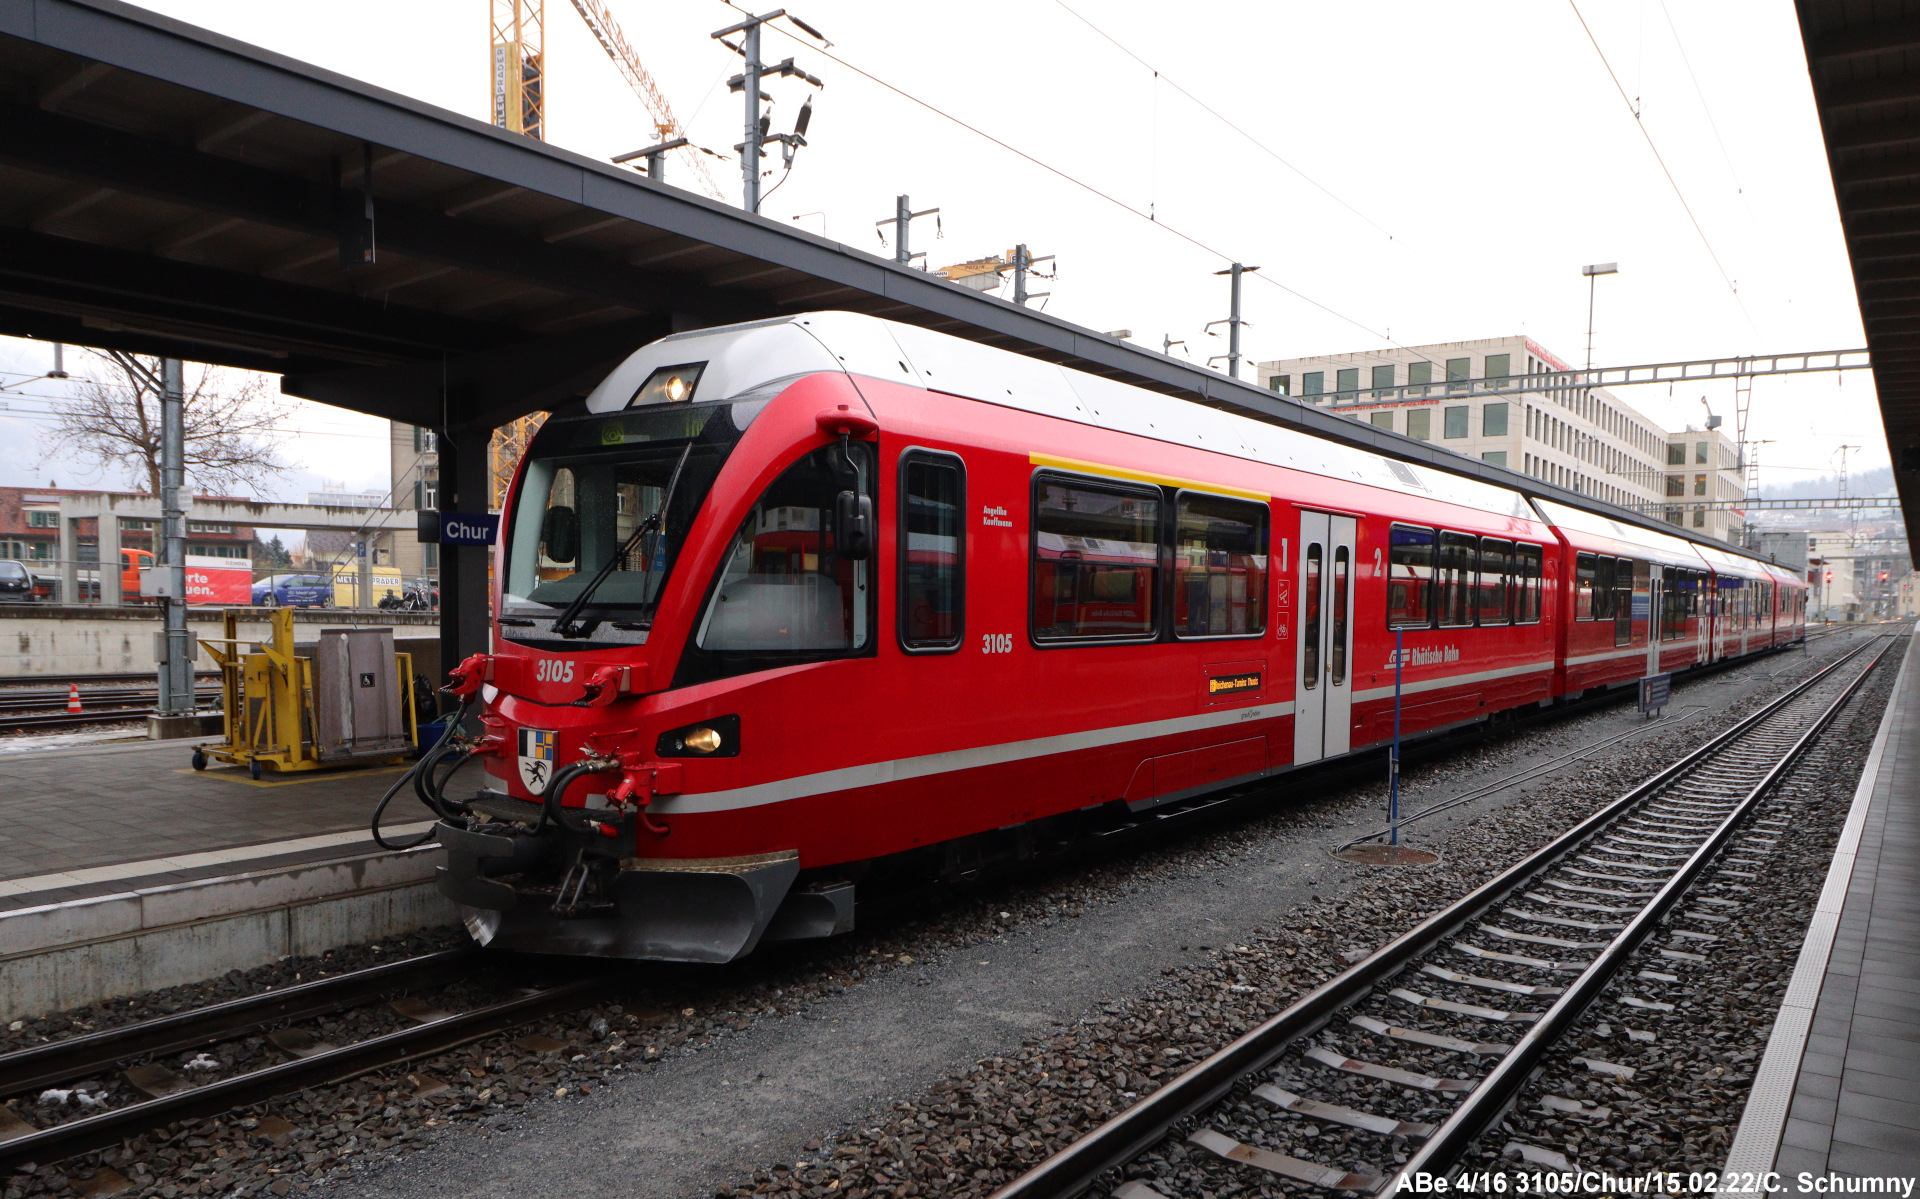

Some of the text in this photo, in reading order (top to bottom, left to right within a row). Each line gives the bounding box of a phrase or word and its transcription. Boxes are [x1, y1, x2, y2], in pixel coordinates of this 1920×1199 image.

[983, 505, 1007, 517] Angelika
[983, 516, 1013, 528] Kauffmann
[446, 521, 490, 540] Chur
[1281, 537, 1288, 572] 1
[1373, 547, 1382, 578] 2
[981, 633, 1013, 655] 3105
[1411, 645, 1443, 666] Rhätische
[1443, 643, 1460, 663] Bahn
[536, 658, 575, 684] 3105
